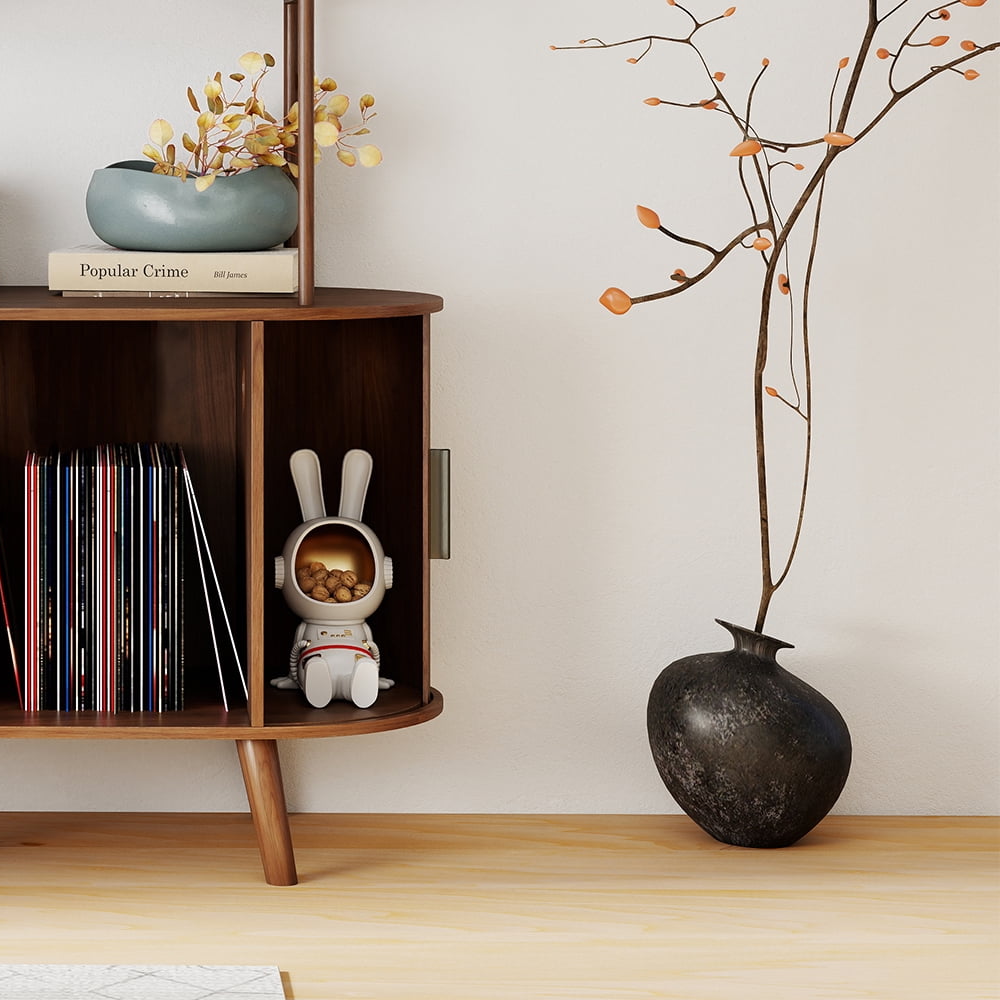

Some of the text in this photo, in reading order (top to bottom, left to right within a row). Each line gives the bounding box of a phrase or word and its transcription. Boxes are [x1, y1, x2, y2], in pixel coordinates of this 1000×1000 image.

[79, 263, 189, 280] Popular Crime
[213, 271, 248, 279] Bill James
